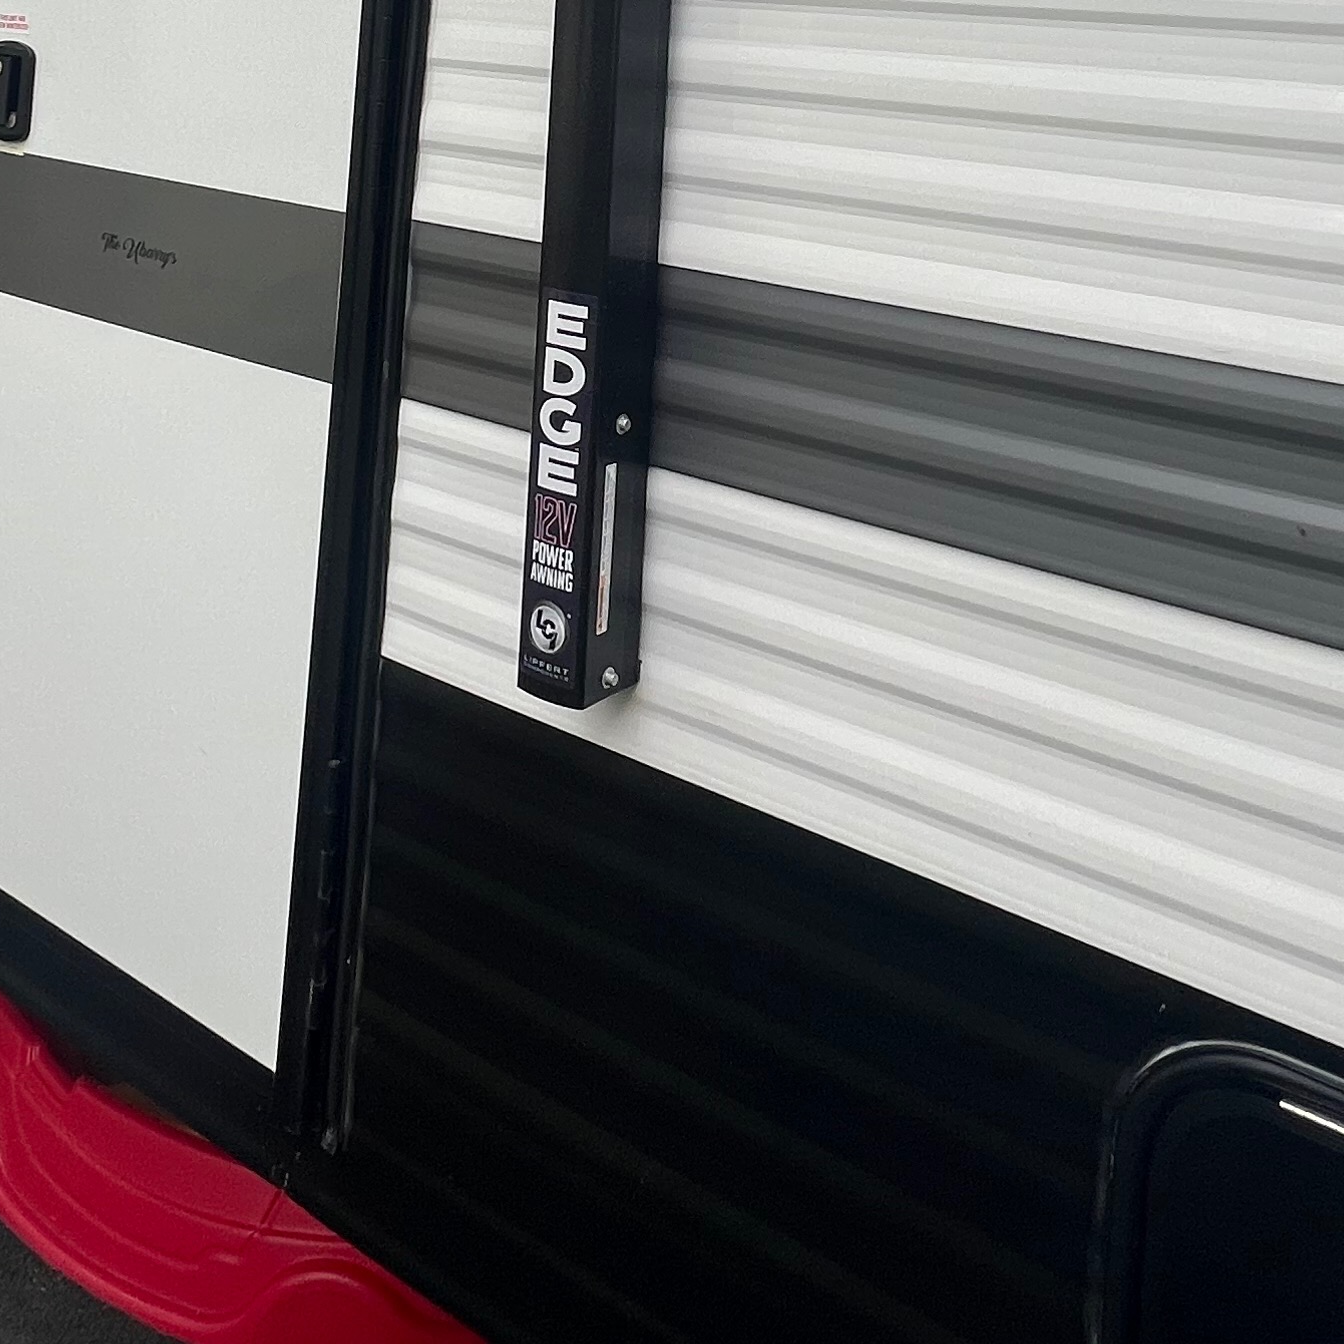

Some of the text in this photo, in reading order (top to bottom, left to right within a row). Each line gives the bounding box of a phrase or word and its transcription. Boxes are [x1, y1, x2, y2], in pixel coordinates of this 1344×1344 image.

[537, 299, 590, 497] EDGE
[534, 493, 578, 549] 12V
[532, 538, 575, 573] POWER
[530, 560, 574, 593] AWNING
[523, 654, 570, 676] LIPPERT
